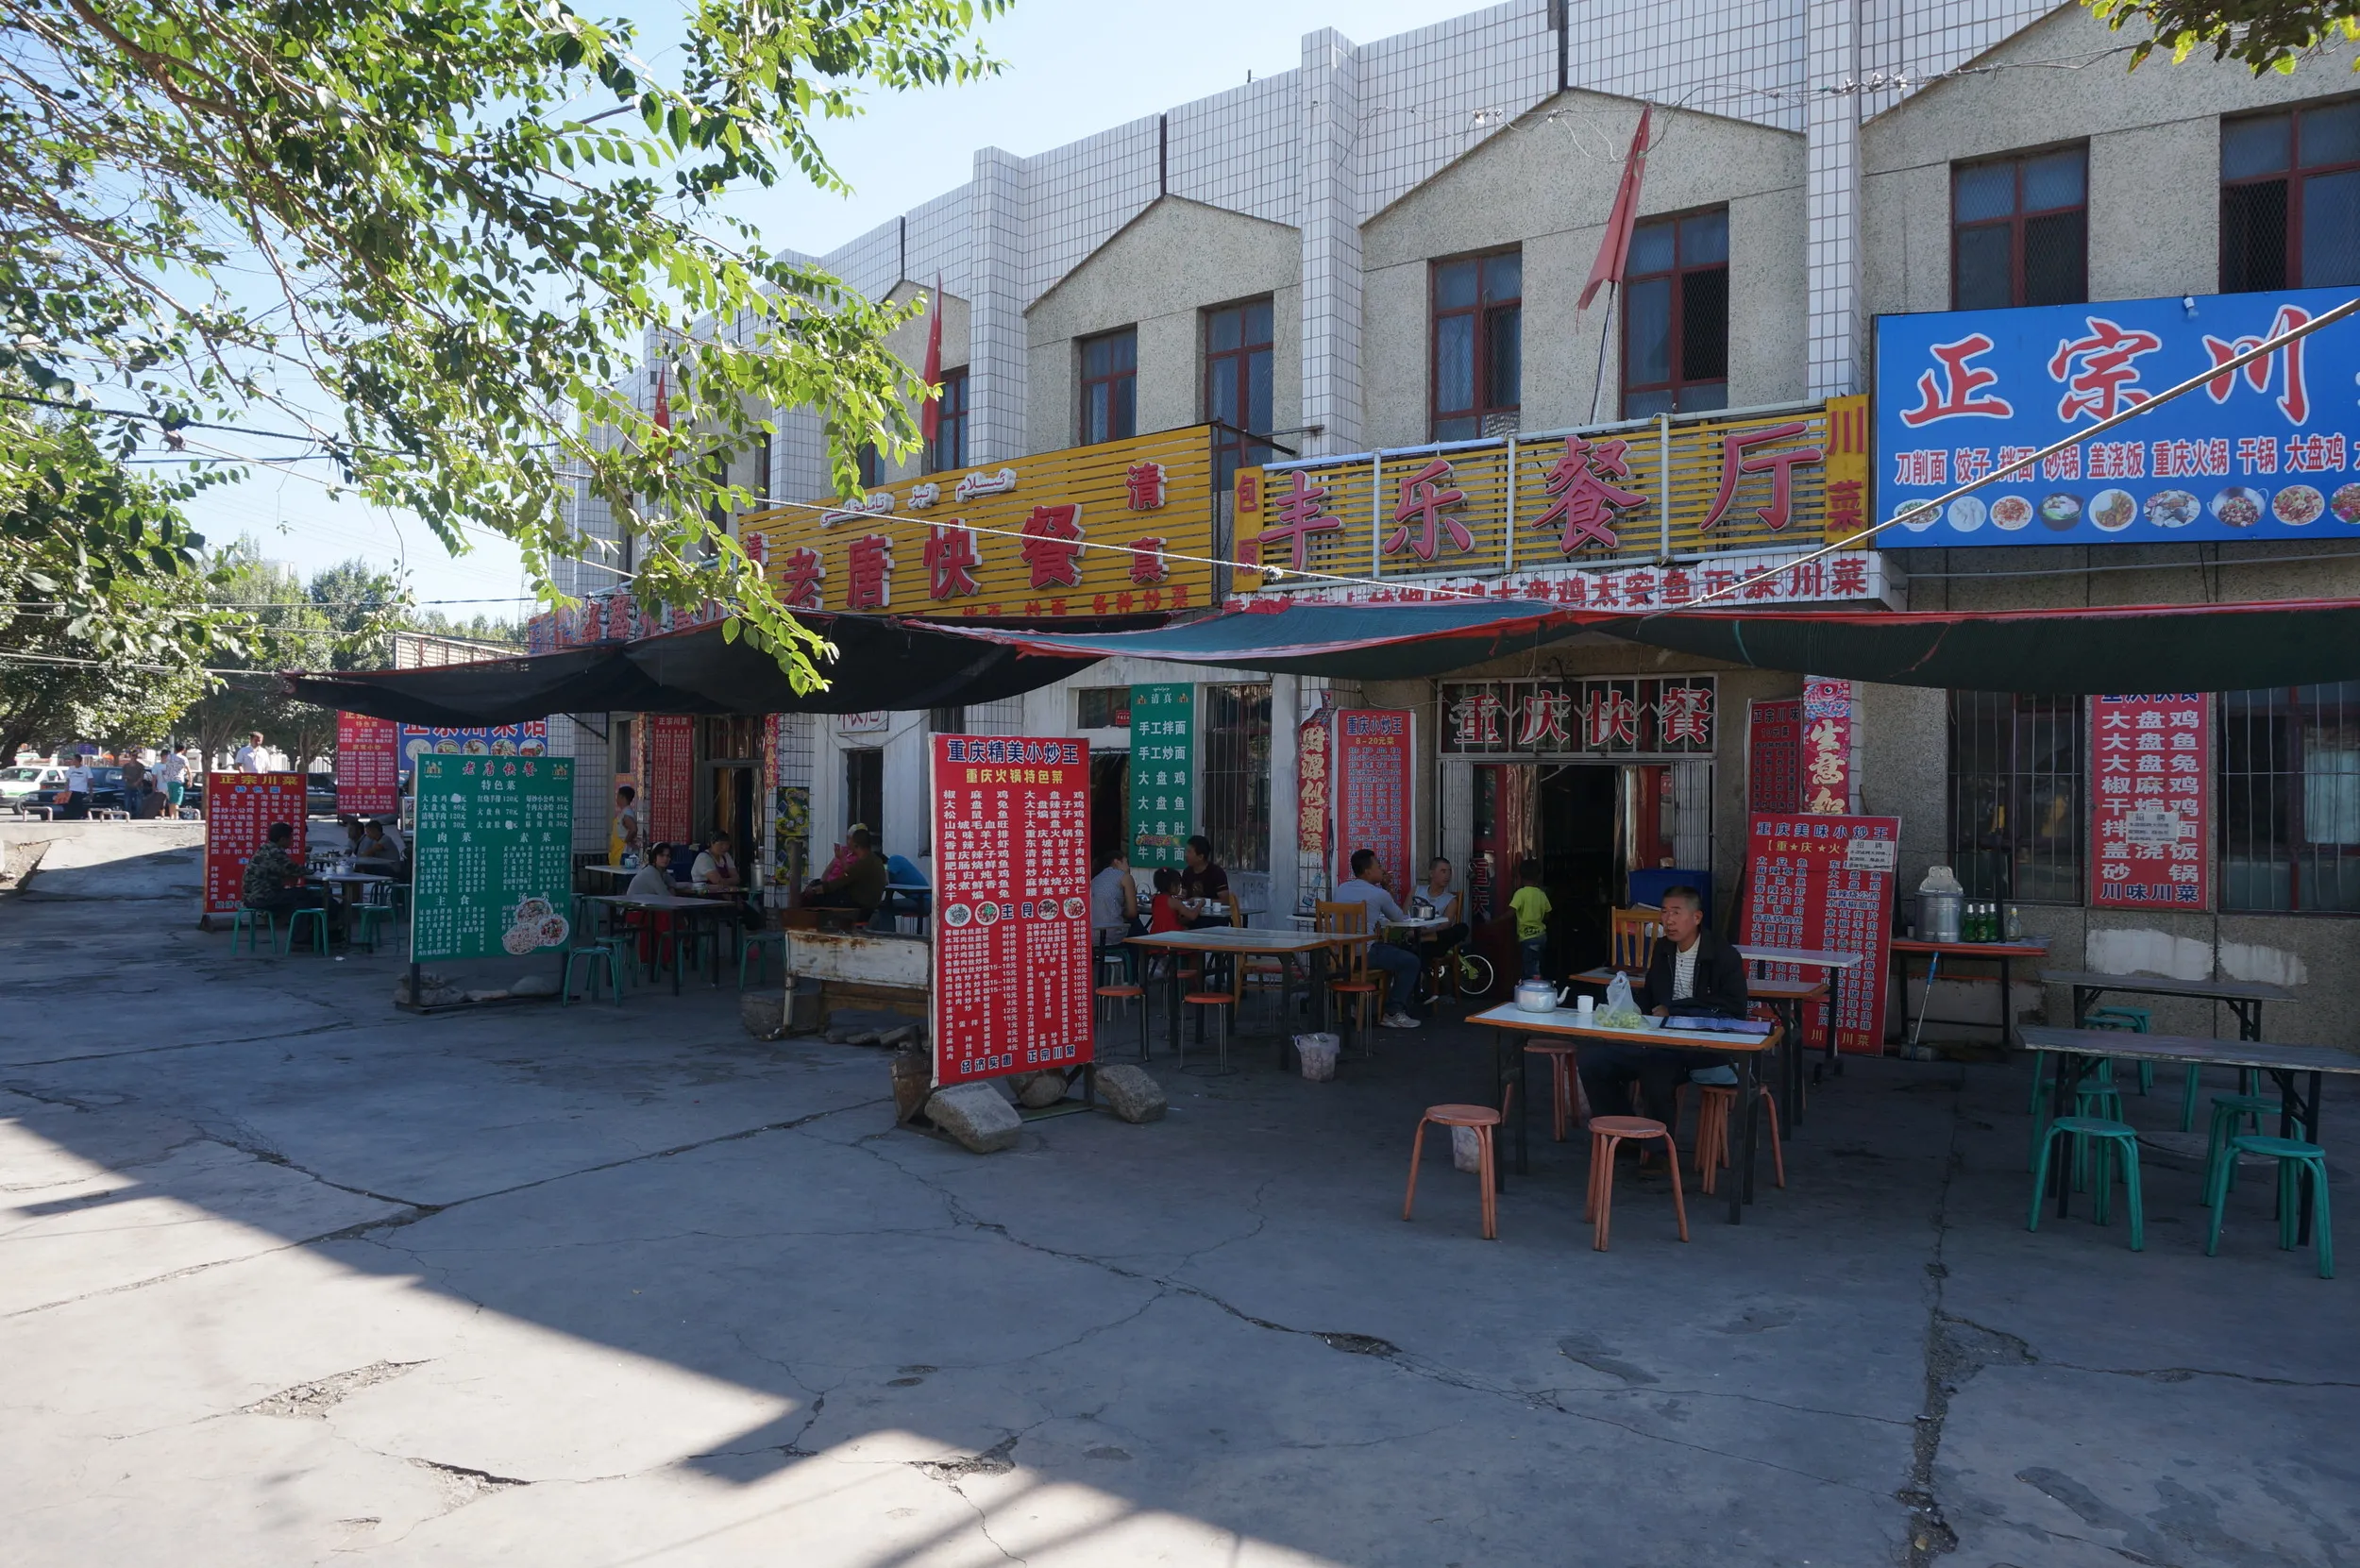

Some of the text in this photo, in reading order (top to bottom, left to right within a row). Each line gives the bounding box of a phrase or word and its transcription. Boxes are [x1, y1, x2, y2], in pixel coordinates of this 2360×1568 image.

[1900, 304, 2360, 428] 正宗川
[1895, 449, 1947, 486] 刀削面
[1954, 447, 1990, 483] 饺子
[2042, 445, 2081, 481] 砂锅
[2088, 441, 2145, 481] 盖浇饭
[2151, 437, 2229, 478] 重庆火锅
[2236, 436, 2277, 475] 干锅
[2284, 432, 2346, 471] 大盘鸡
[1256, 421, 1825, 568] 丰乐餐厅
[1125, 462, 1169, 585] 清真
[783, 503, 1085, 611] 老唐快餐
[1092, 585, 1189, 615] 各种炒菜
[1151, 693, 1172, 703] 清真
[1452, 687, 1713, 747] 重庆快餐
[2100, 710, 2200, 729] 大盘鸡
[1138, 720, 1187, 735] 手工拌面
[1347, 715, 1404, 735] 重庆小炒王
[2100, 733, 2200, 751] 大盘鱼
[947, 739, 1079, 765] 重庆精美小炒王
[1138, 746, 1187, 761] 手工炒面
[463, 760, 538, 778] 老唐快餐
[2100, 754, 2200, 773] 大盘兔
[219, 775, 298, 785] 正宗川菜
[966, 768, 1064, 784] 重庆火锅特色菜
[1138, 770, 1186, 785] 大盘鸡
[480, 780, 516, 791] 特色菜
[2100, 776, 2200, 794] 椒麻鸡
[944, 790, 1010, 800] 椒麻鸡
[1025, 790, 1085, 800] 大盘鸡
[944, 800, 1010, 809] 大盘兔
[1025, 800, 1085, 809] 大盘辣子鸡
[1138, 796, 1186, 810] 大盘鱼
[944, 810, 1010, 819] 松鼠鱼
[944, 820, 1010, 830] 山城毛血旺
[1025, 819, 1085, 829] 大盘鱼
[1138, 820, 1186, 835] 大盘肚
[1755, 821, 1889, 840] 重庆美味小炒王
[944, 830, 1010, 840] 风味羊排
[1025, 829, 1085, 838] 重庆火锅鱼
[944, 840, 1010, 850] 香辣大虾
[1025, 838, 1085, 848] 东坡肘子
[944, 850, 1010, 860] 重庆辣子鸡
[1025, 848, 1085, 858] 清炖羊肉
[1138, 846, 1185, 861] 牛肉面
[2100, 841, 2200, 861] 盖浇饭
[1025, 858, 1085, 868] 香辣草鱼
[944, 869, 1010, 881] 当归炖鸡
[1025, 867, 1085, 877] 炒小公鸡
[1828, 869, 1881, 882] 大盘鱼
[2100, 864, 2200, 883] 砂锅
[1025, 876, 1085, 887] 麻辣烧公鸡
[1828, 880, 1880, 891] 大盘鸡
[2100, 883, 2200, 902] 川味川菜
[1753, 895, 1805, 906] 水煮肉片
[1001, 902, 1034, 919] 主食
[1825, 919, 1878, 931] 青椒羊肉
[1811, 1029, 1870, 1047] 川川菜
[1027, 1044, 1075, 1064] 正宗川菜
[961, 1053, 1012, 1074] 经济实惠
